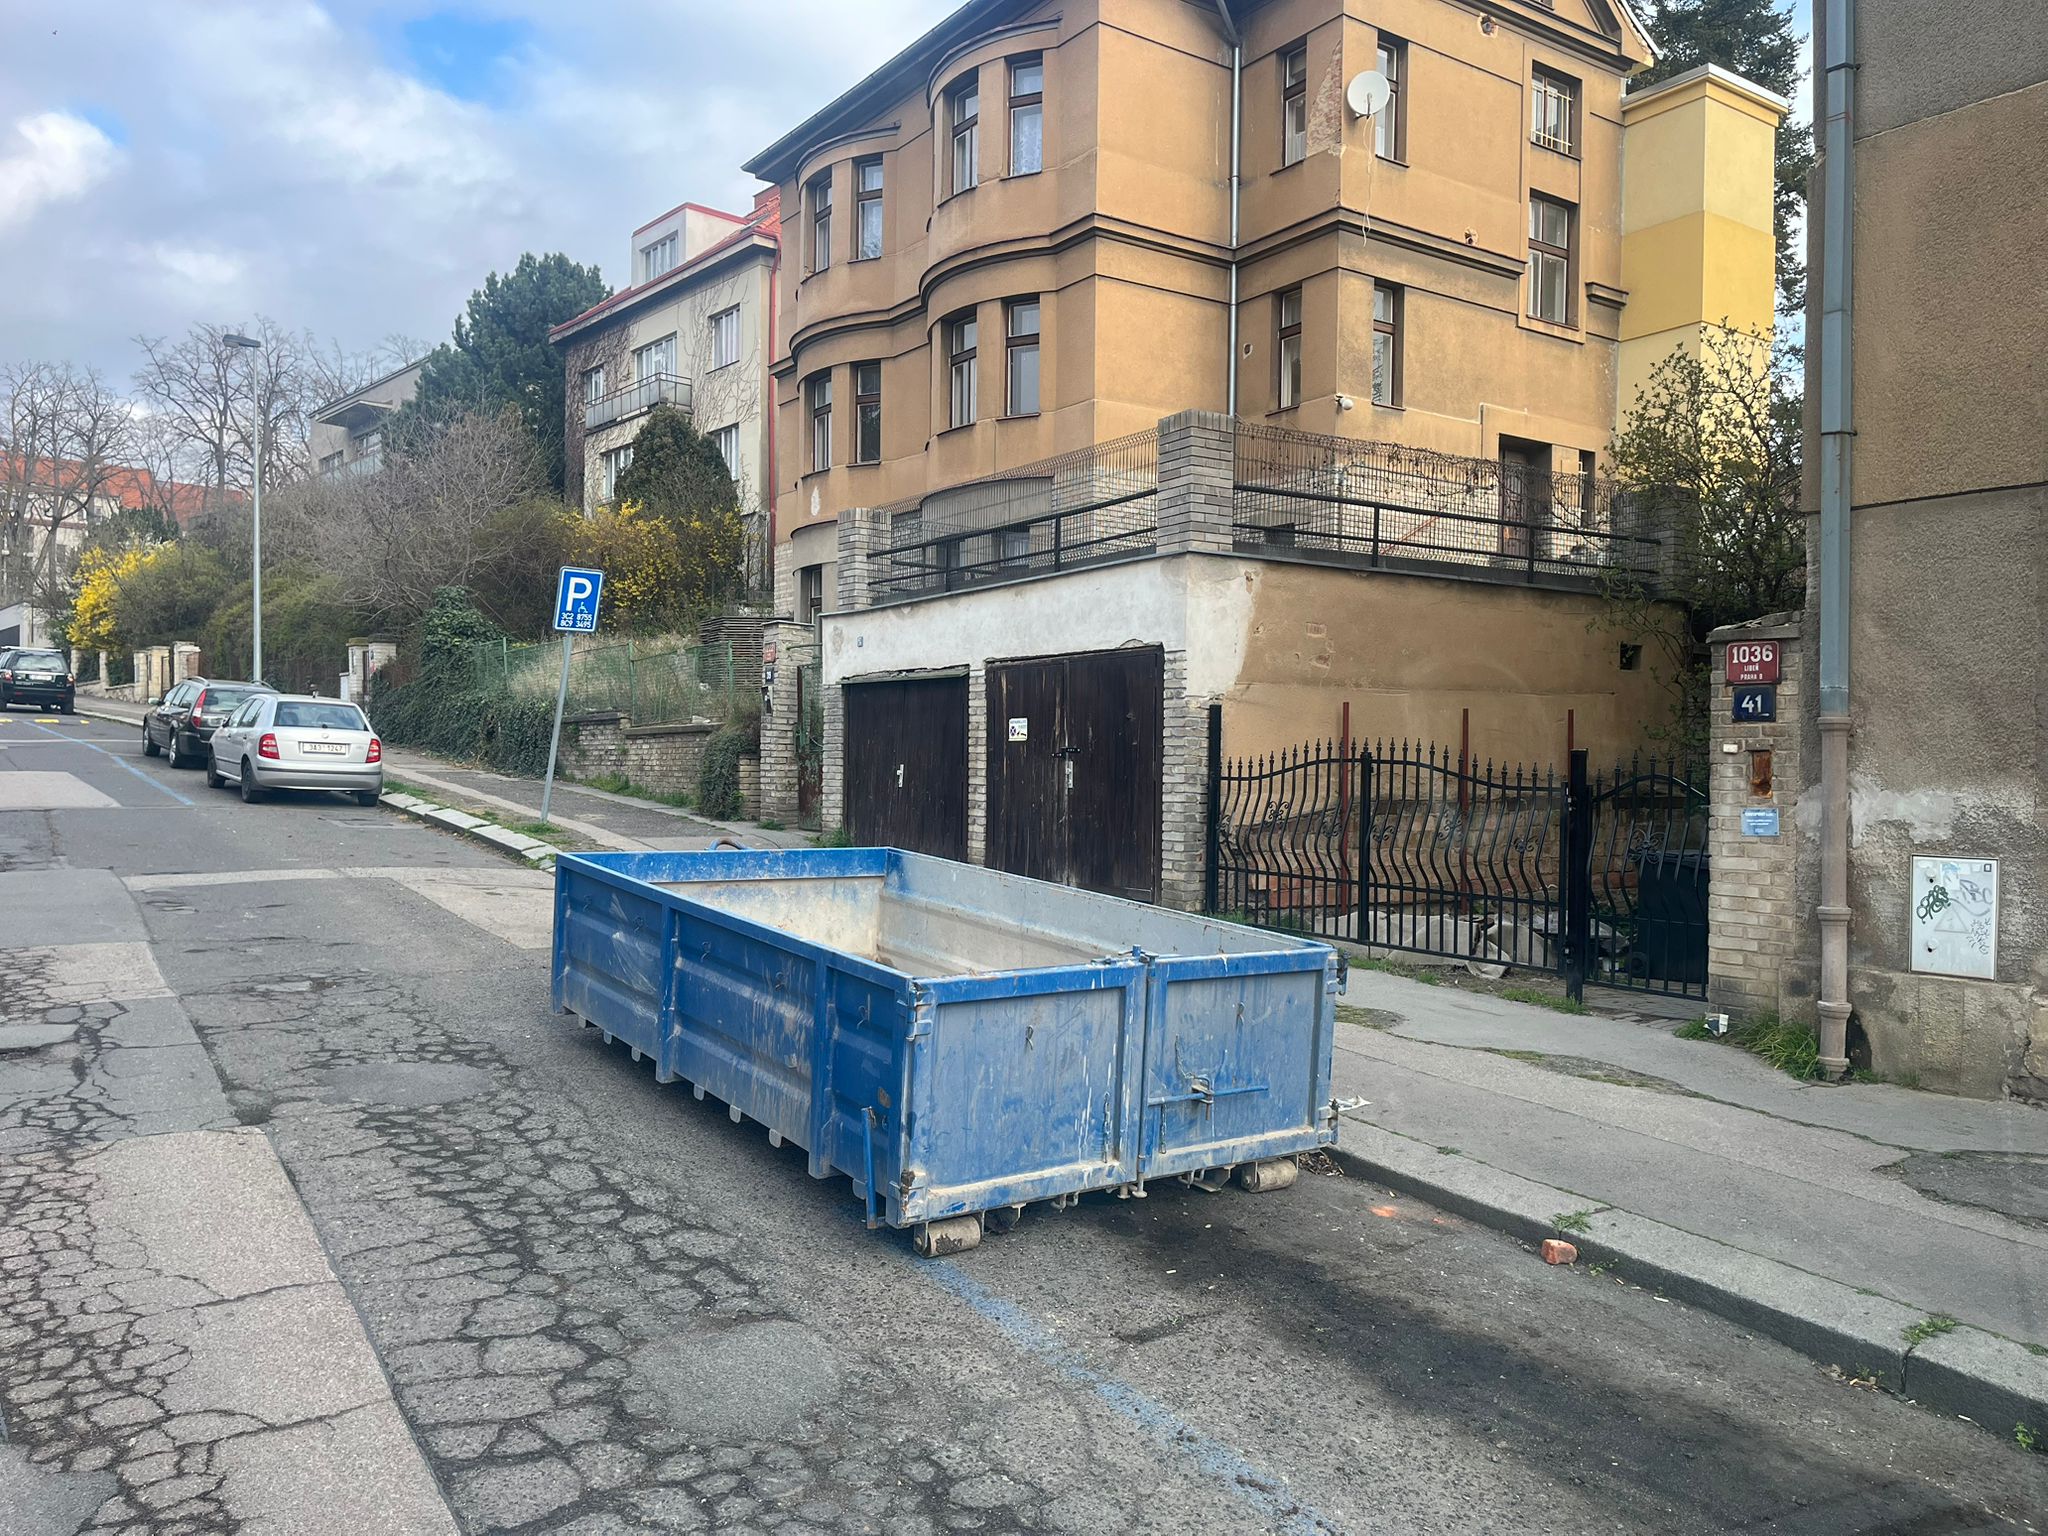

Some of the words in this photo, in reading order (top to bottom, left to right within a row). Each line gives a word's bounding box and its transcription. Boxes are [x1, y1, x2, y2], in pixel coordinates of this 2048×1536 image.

[566, 577, 592, 611] P
[1732, 645, 1773, 663] 1036
[1741, 694, 1762, 713] 41
